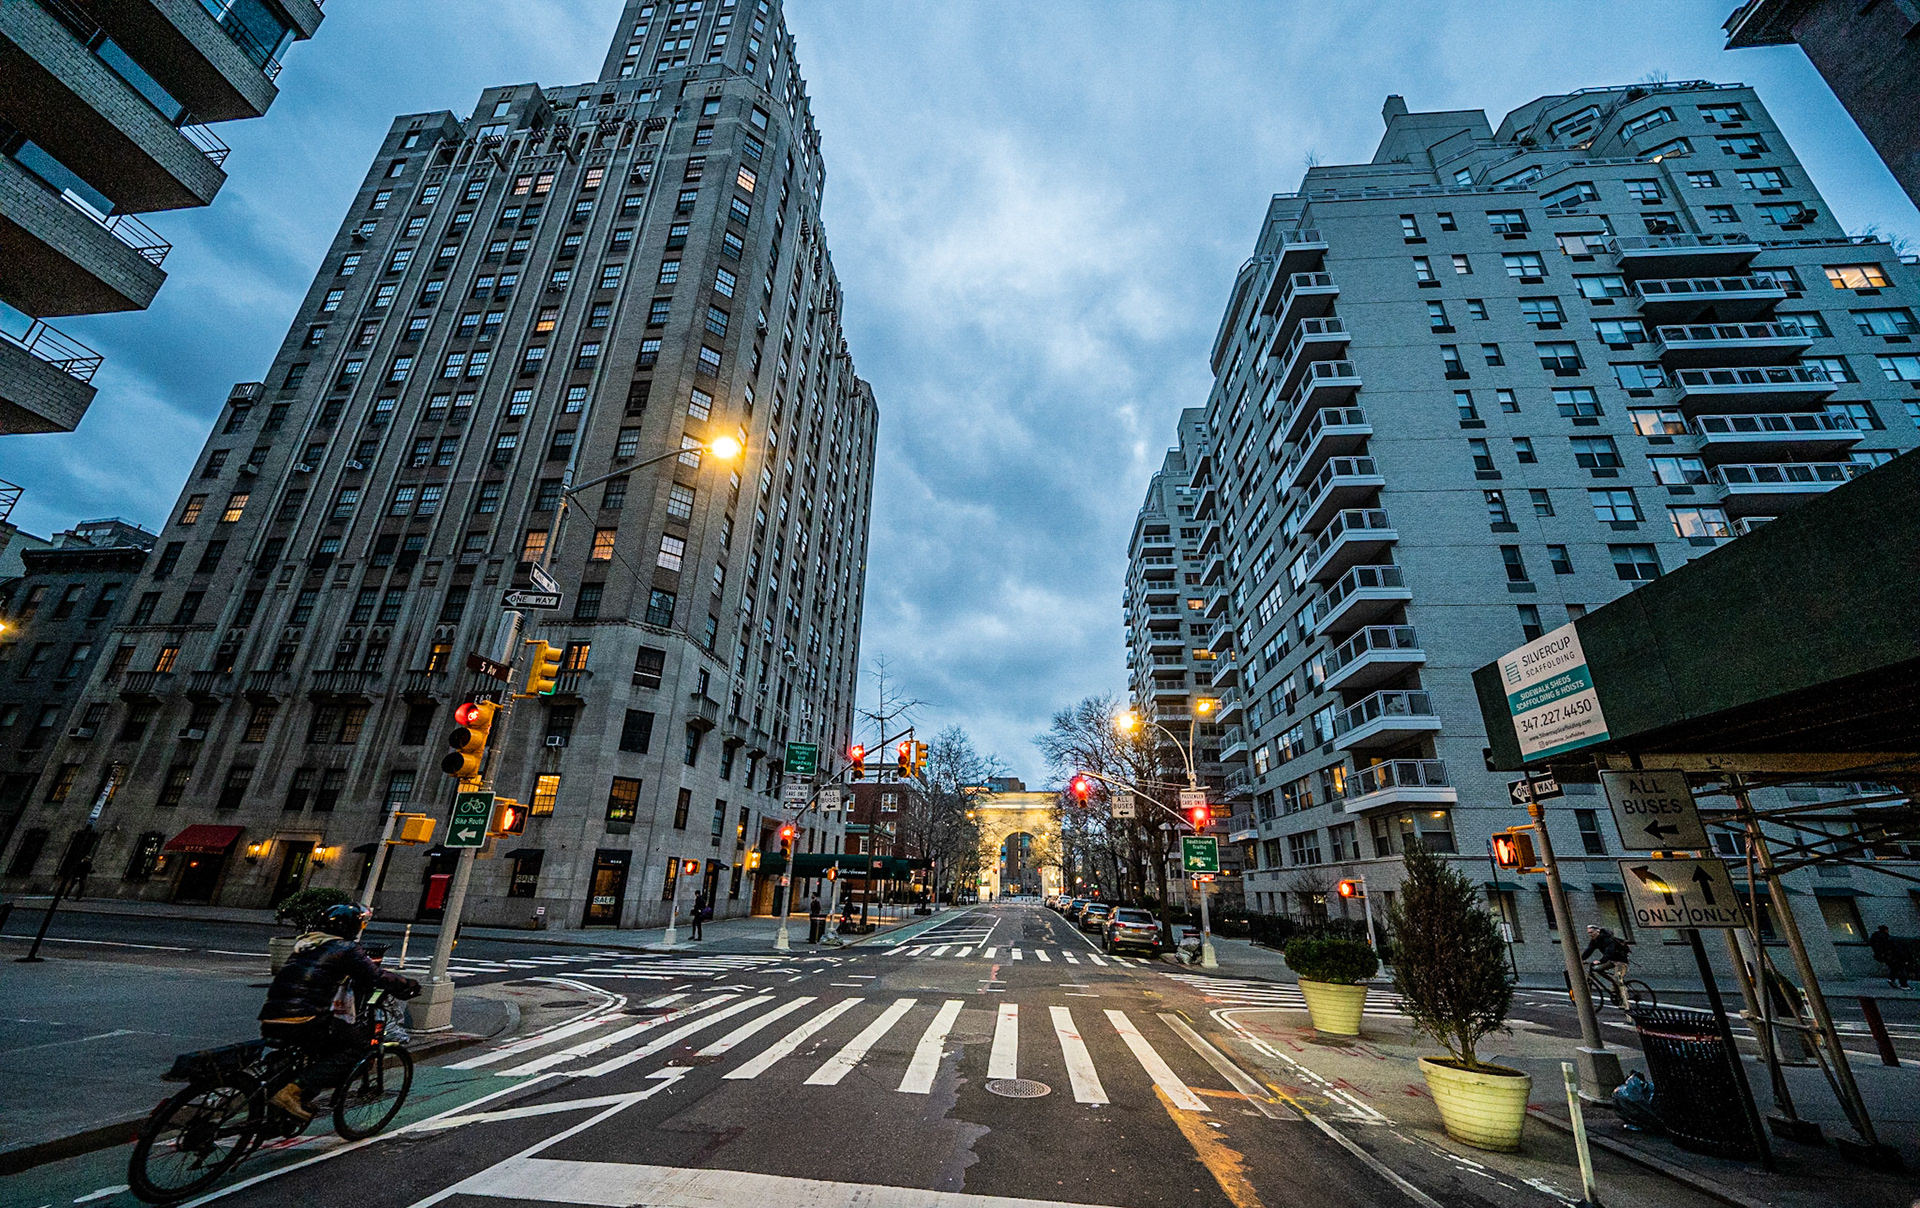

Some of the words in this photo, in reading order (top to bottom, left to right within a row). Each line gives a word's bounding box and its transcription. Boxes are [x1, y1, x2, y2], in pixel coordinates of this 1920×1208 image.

[510, 595, 528, 603] ONE
[535, 596, 554, 604] WAY
[1521, 636, 1571, 667] SILVERCUP
[480, 661, 487, 672] 5
[487, 664, 497, 676] Av
[1525, 651, 1575, 678] SCAFFOLDING
[1520, 684, 1550, 701] SIDEWALK
[1550, 674, 1571, 690] SHEDS
[1516, 691, 1556, 711] SCAFFOLDING
[1555, 688, 1561, 697] &
[1561, 680, 1585, 694] HOISTS
[1521, 698, 1592, 733] 347.227.4450
[789, 744, 816, 752] Southbound
[1537, 781, 1554, 793] WAY
[1629, 779, 1665, 794] ALL
[1622, 799, 1683, 815] BUSES
[455, 817, 467, 825] Bike
[468, 817, 485, 825] Route
[594, 896, 615, 905] SALE
[1637, 908, 1684, 922] ONLY
[1691, 908, 1738, 922] ONLY
